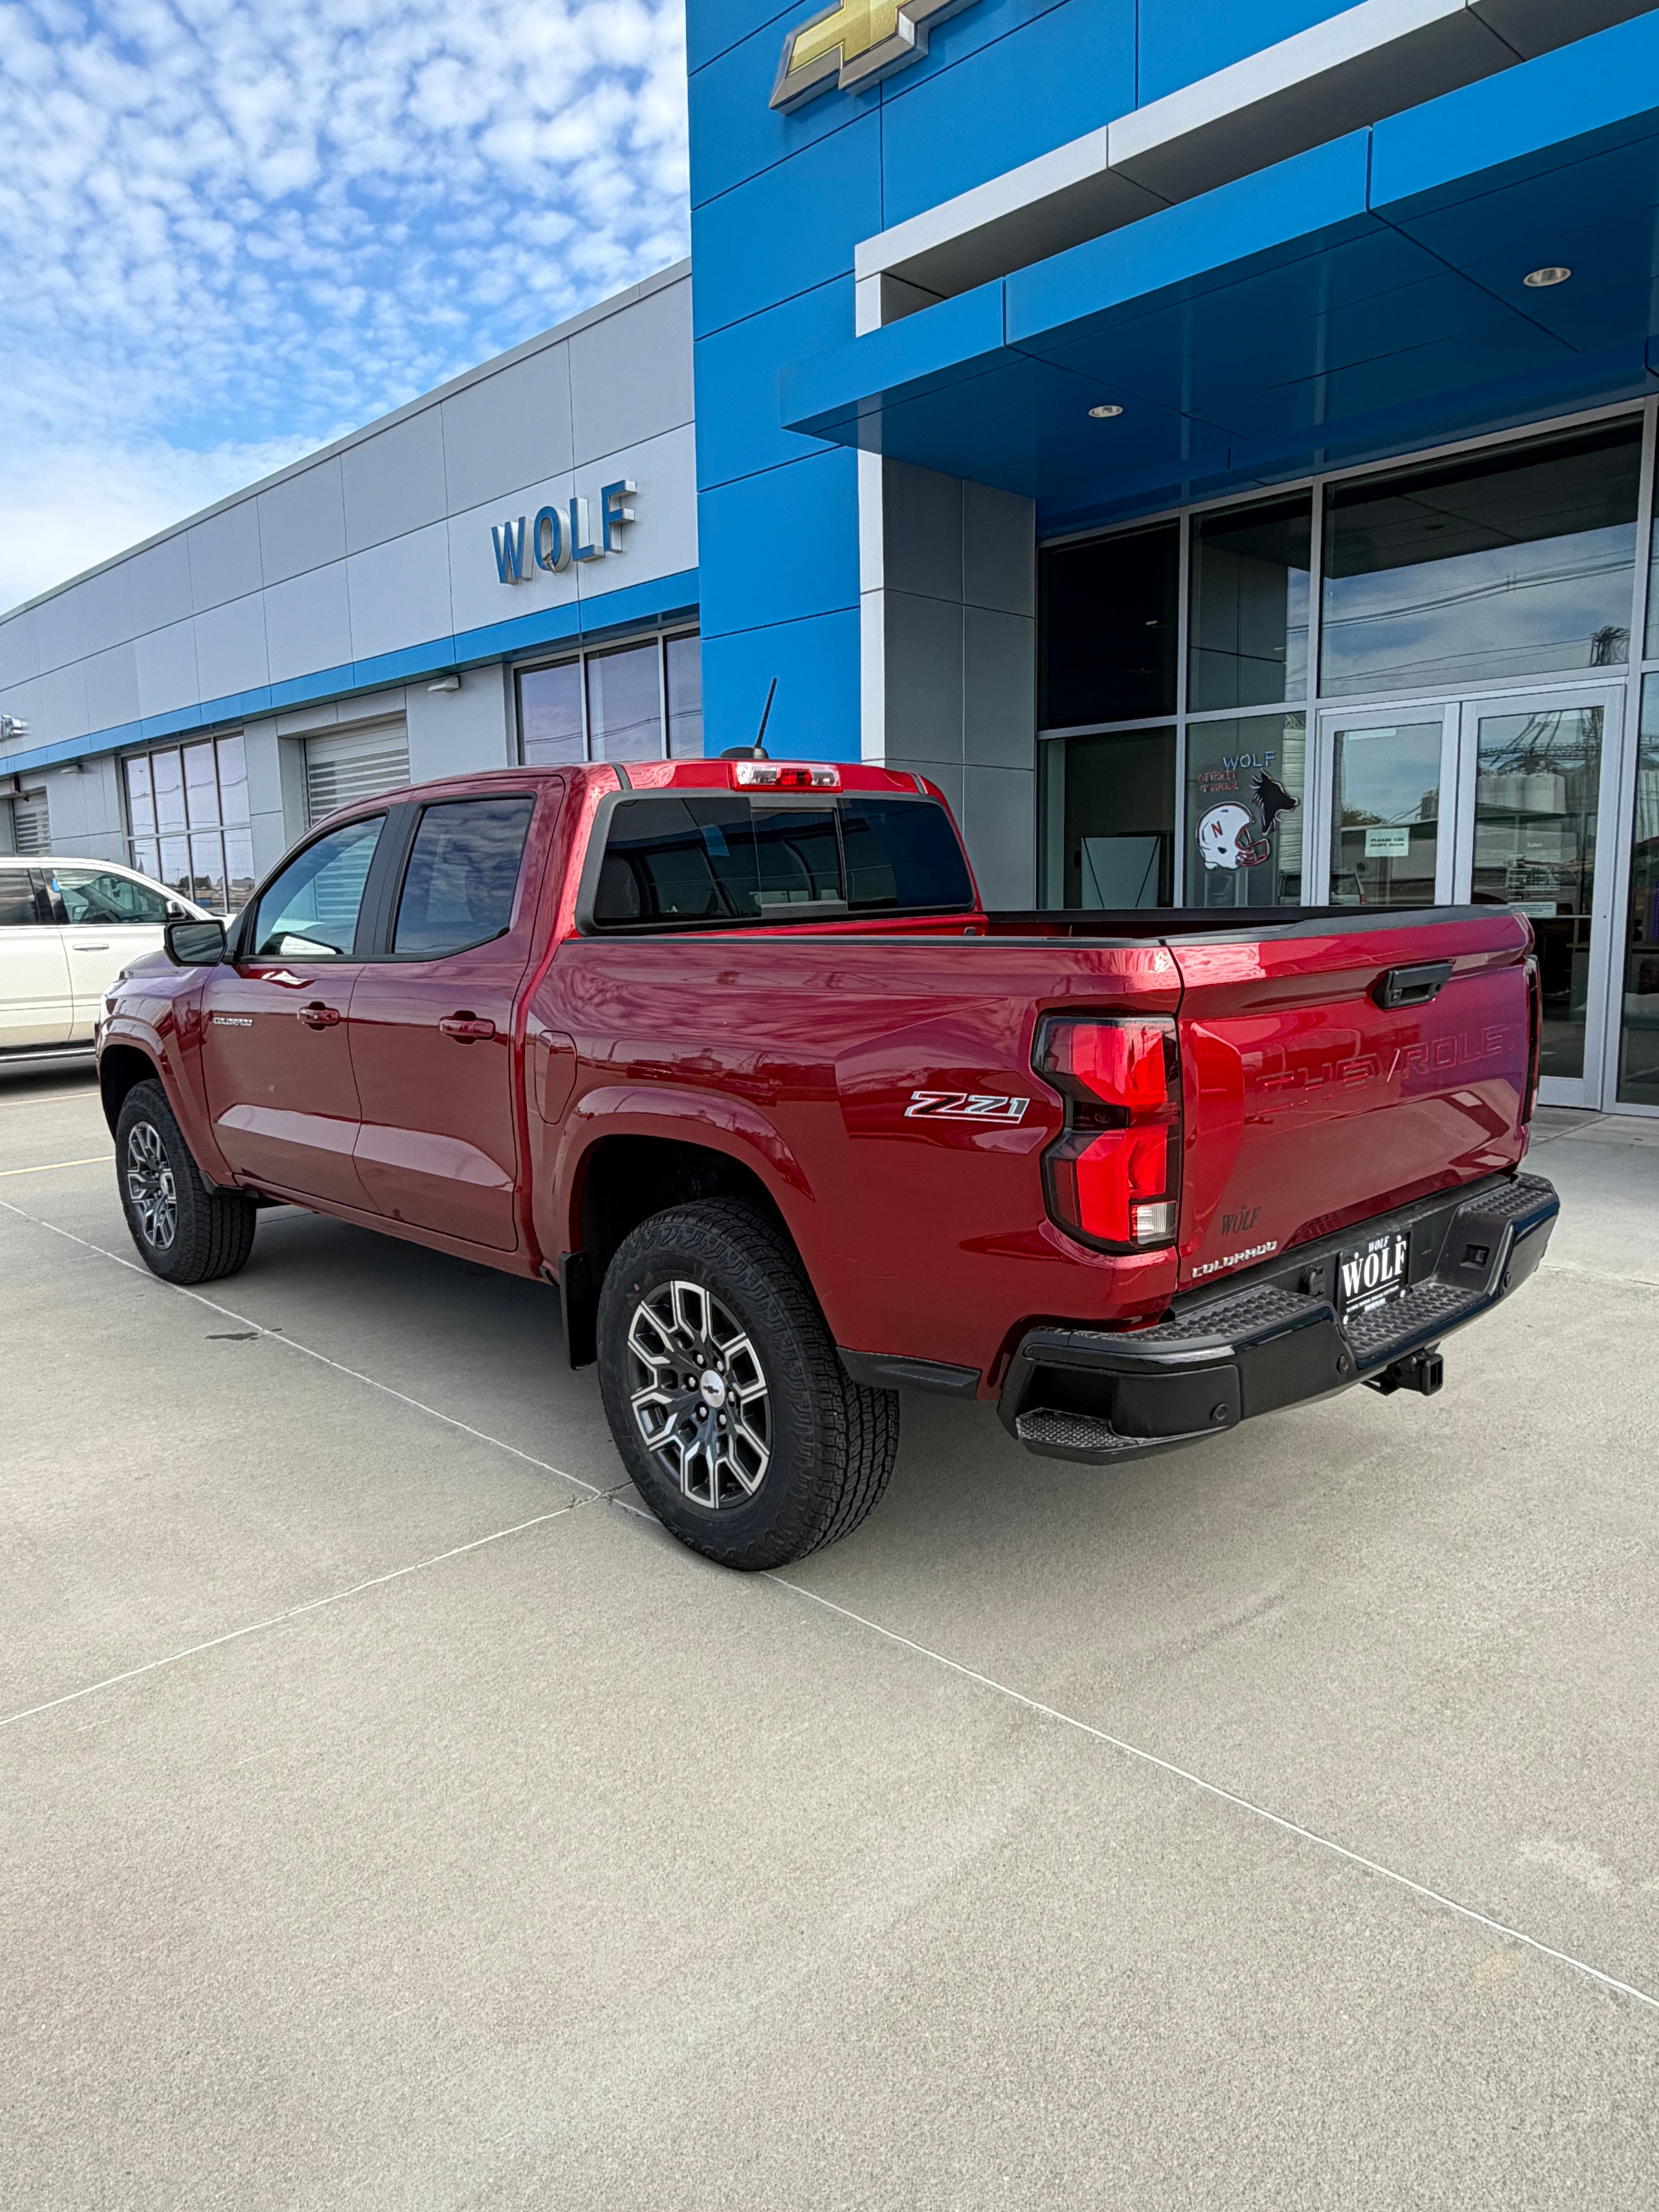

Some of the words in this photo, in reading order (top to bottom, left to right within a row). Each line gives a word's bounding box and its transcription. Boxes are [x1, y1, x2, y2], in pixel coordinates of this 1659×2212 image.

[491, 479, 637, 584] WOLF
[1223, 751, 1275, 771] WOLF
[1211, 821, 1223, 838] N
[1255, 1022, 1522, 1114] CHEVROLET
[904, 1091, 1030, 1124] Z71
[1221, 1206, 1261, 1233] WOLF
[1192, 1240, 1277, 1278] COLORADO
[1342, 1240, 1407, 1297] WOLF
